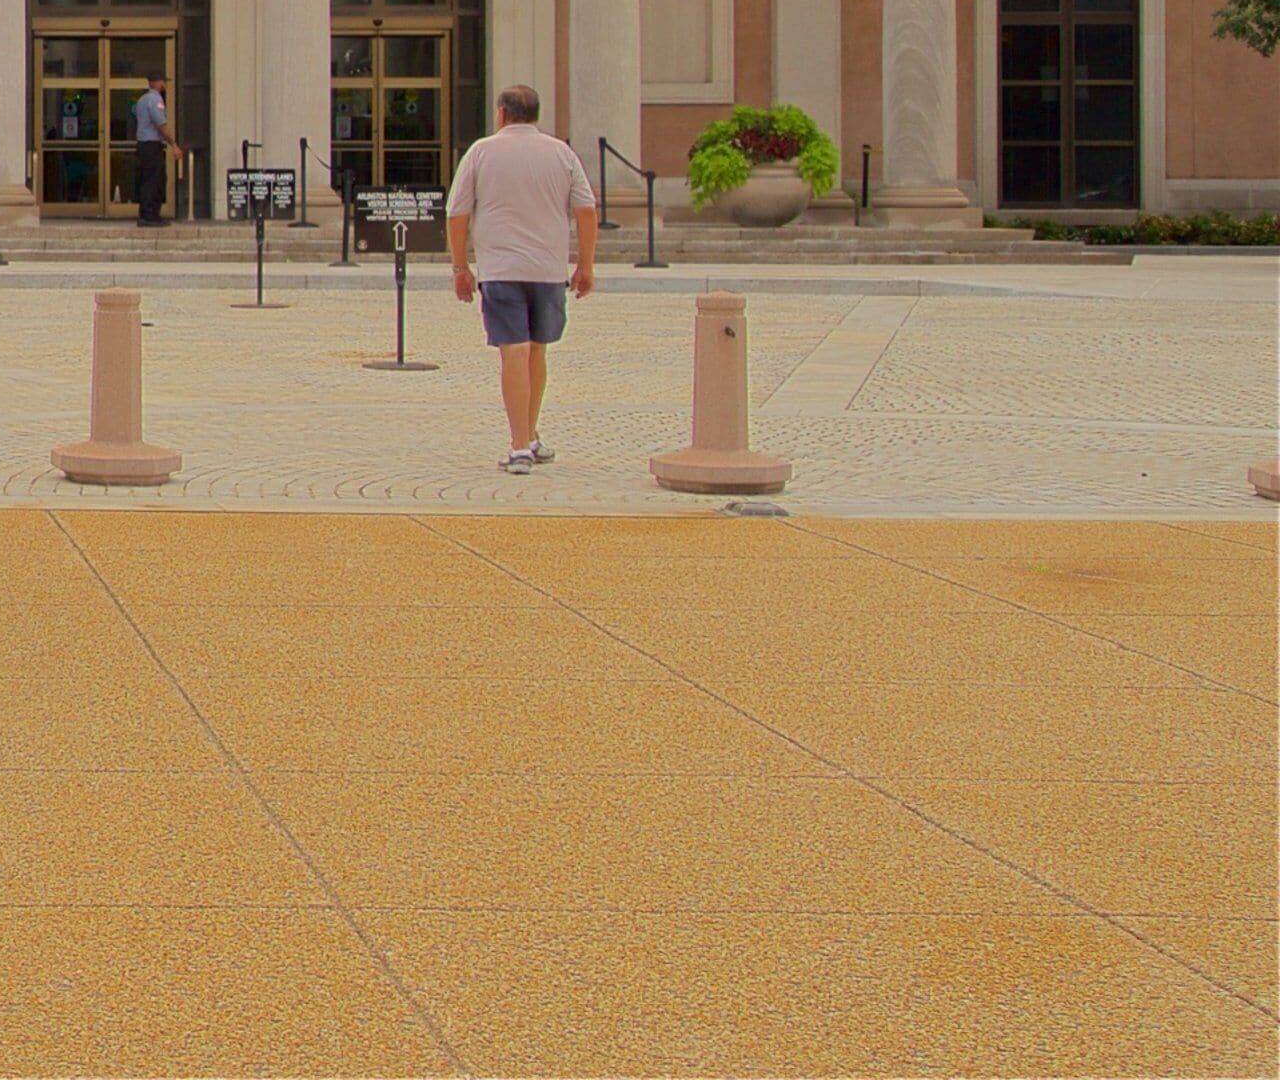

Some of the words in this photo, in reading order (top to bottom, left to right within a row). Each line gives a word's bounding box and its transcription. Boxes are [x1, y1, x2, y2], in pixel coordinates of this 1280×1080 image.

[357, 192, 387, 200] ARLINGTON
[388, 192, 415, 200] NATIONAL
[416, 192, 444, 200] CEMETERY
[367, 200, 387, 208] VISITOR
[388, 200, 417, 208] SCREENING
[418, 200, 434, 208] AREA
